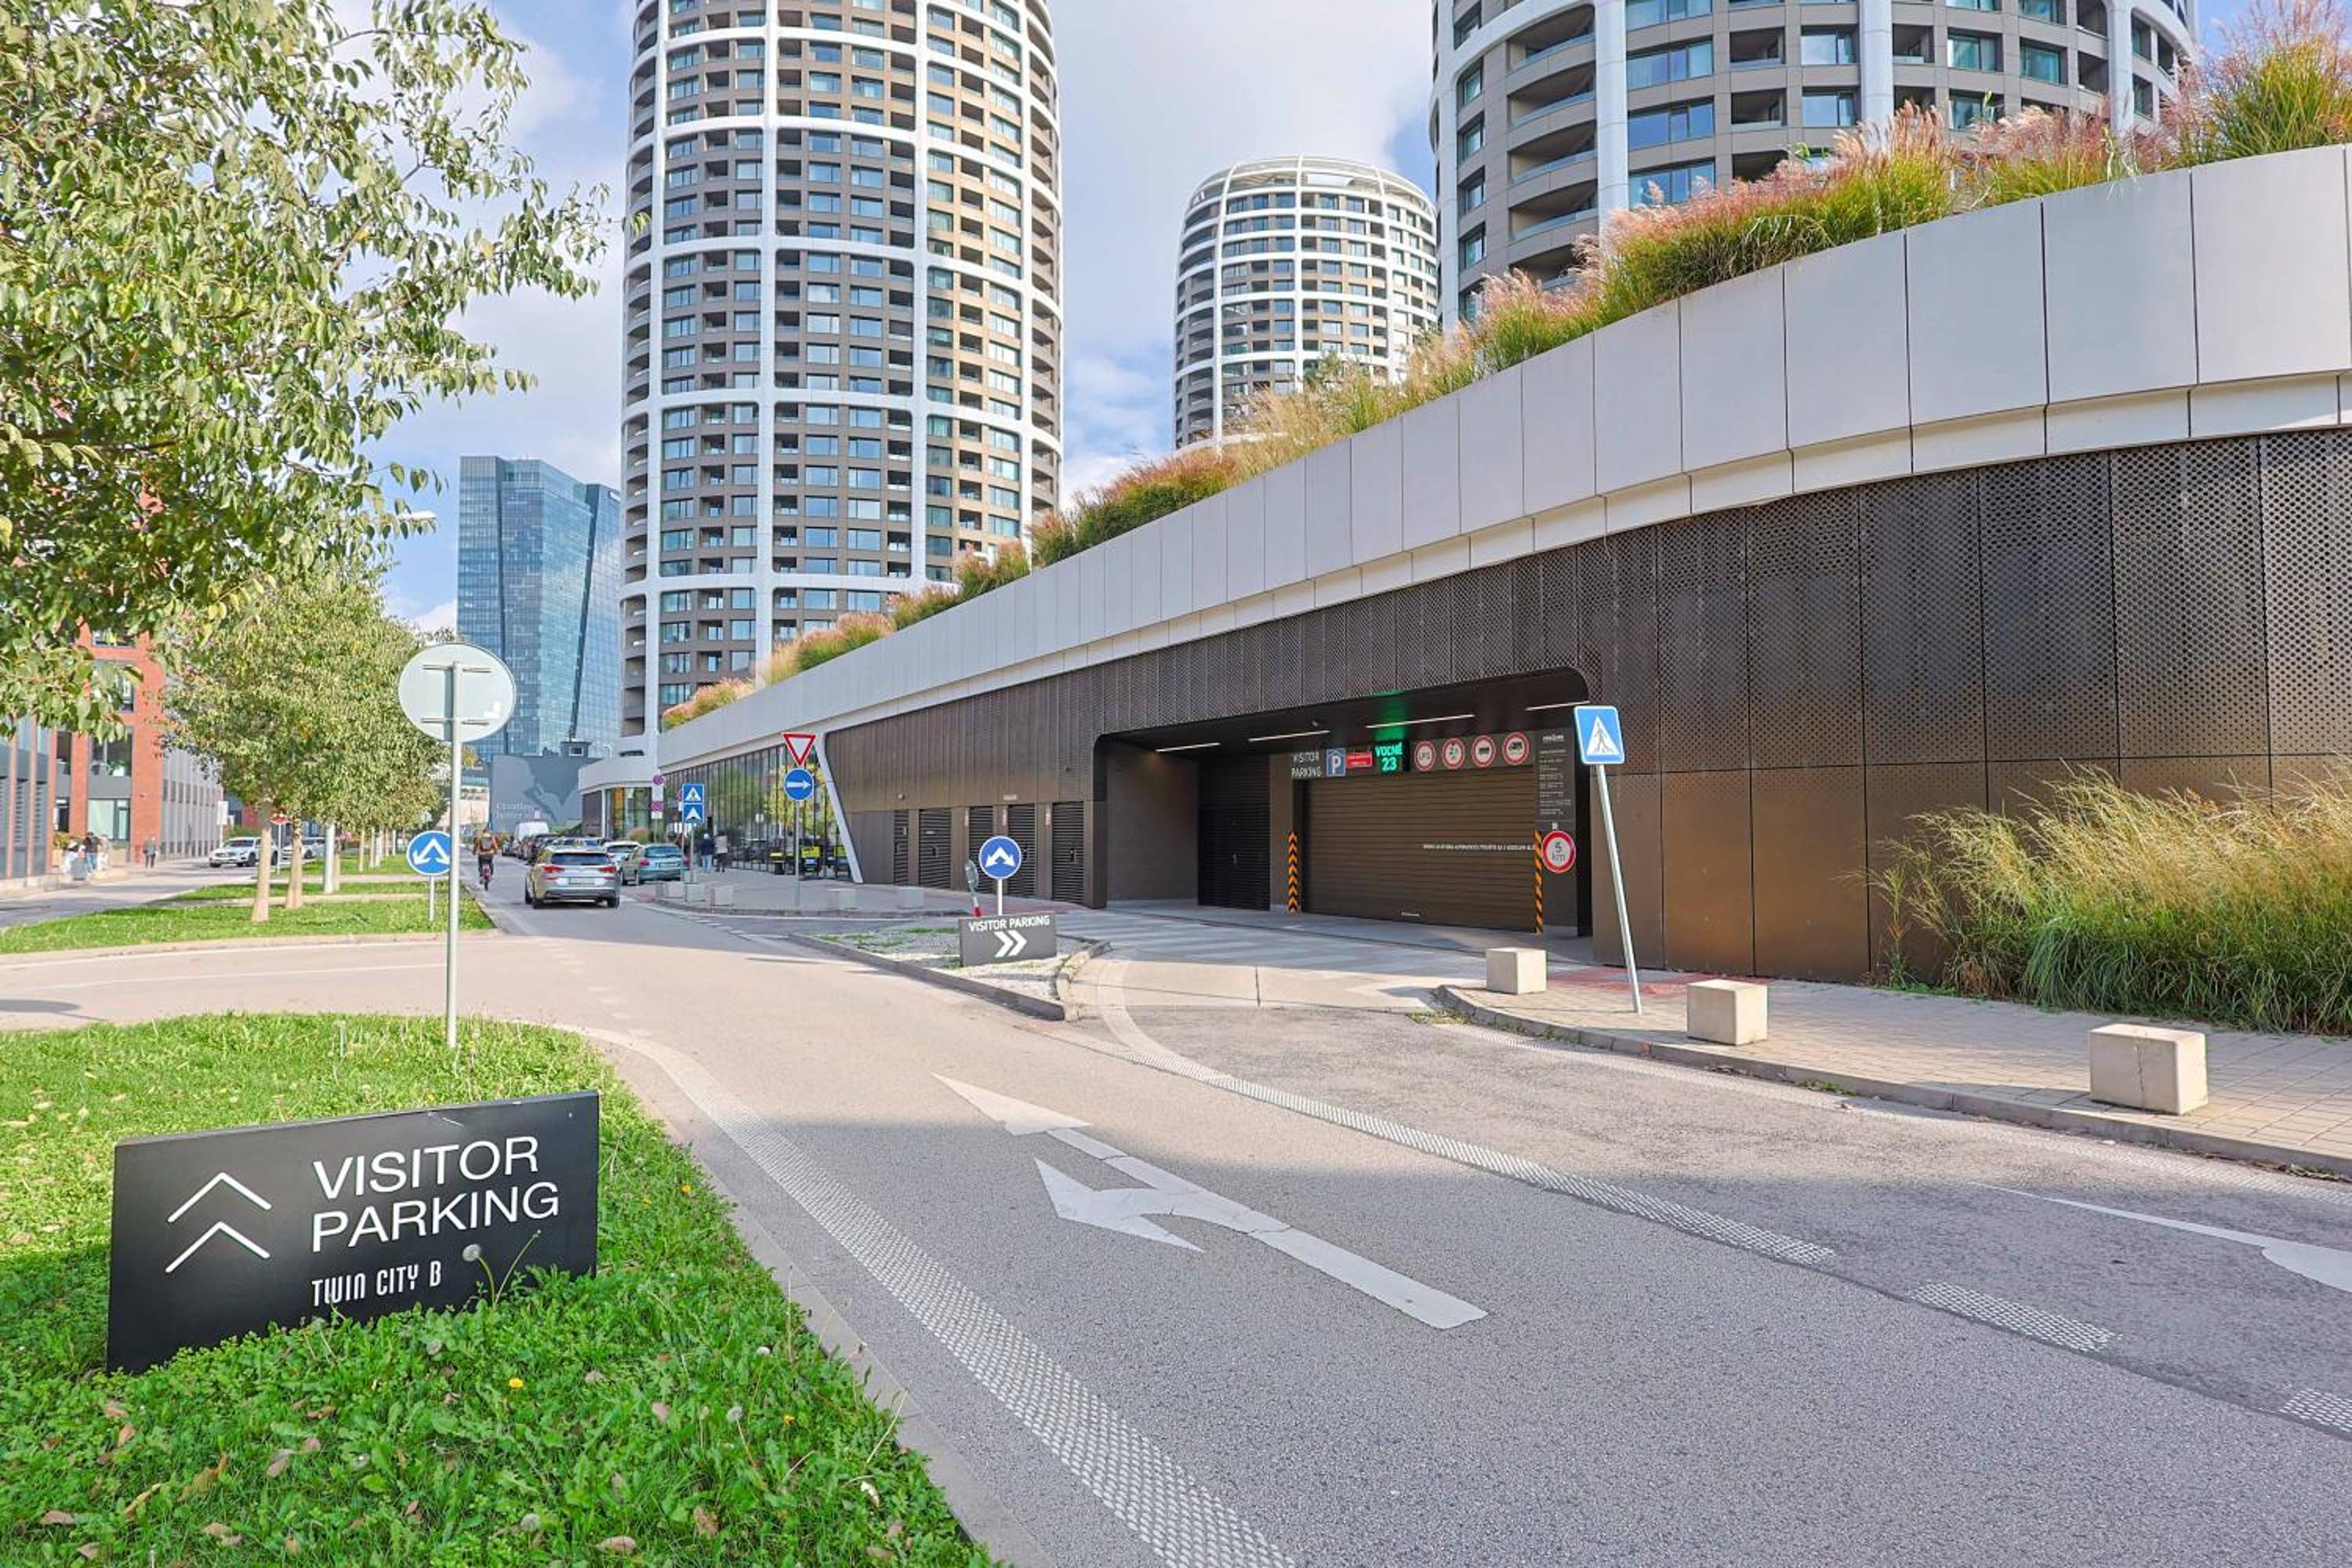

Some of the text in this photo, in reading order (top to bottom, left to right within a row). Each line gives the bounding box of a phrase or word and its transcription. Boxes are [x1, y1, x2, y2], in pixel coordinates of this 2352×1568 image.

[1291, 752, 1319, 763] VISITOR
[1332, 755, 1341, 775] P
[1382, 757, 1397, 771] 23
[1291, 766, 1323, 778] PARKING
[1555, 841, 1563, 852] 5
[968, 915, 1050, 932] VISITOR PARKING
[314, 1136, 539, 1200] VISITOR
[312, 1181, 559, 1252] PARKING
[311, 1260, 441, 1306] TWIN CITY B
